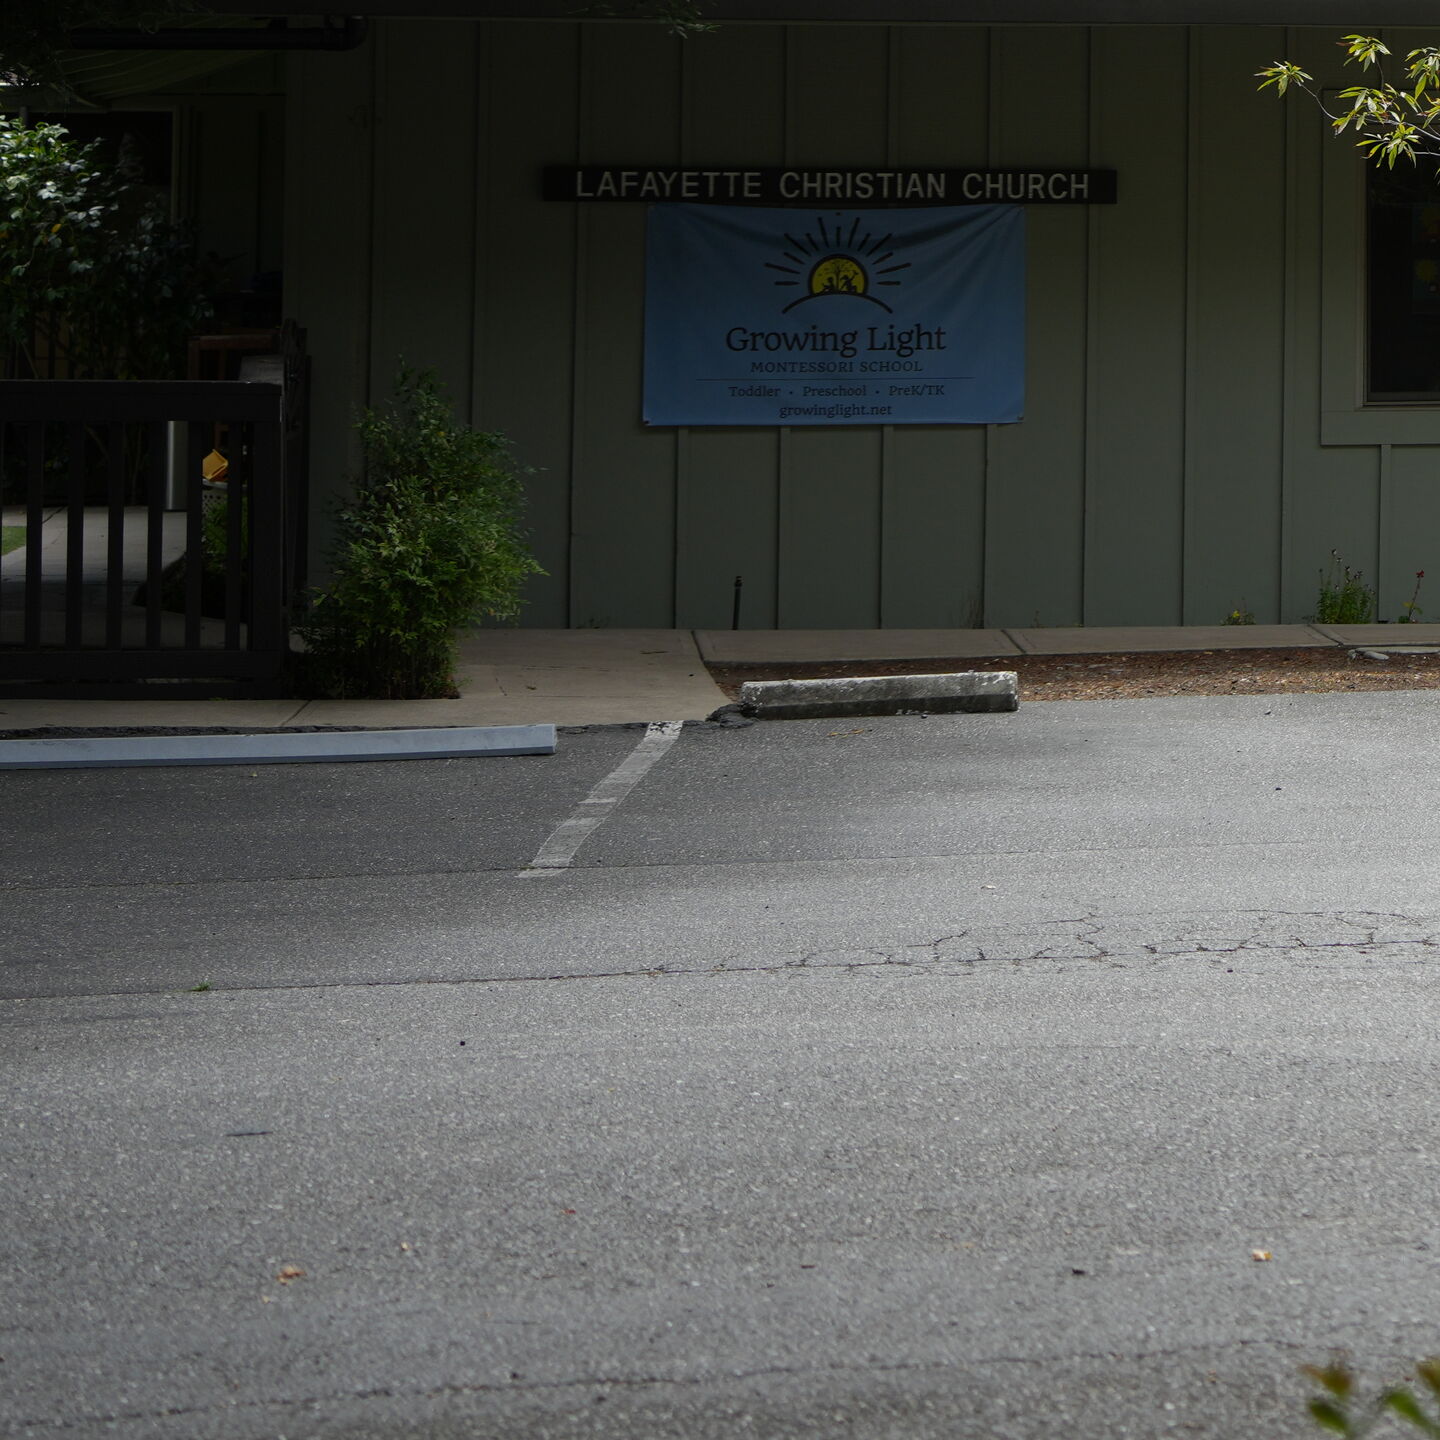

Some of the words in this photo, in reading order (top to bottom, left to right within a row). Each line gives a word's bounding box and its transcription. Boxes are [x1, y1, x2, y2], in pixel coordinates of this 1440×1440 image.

[576, 171, 761, 198] LAFAYETTE
[779, 172, 946, 199] CHRISTIAN
[962, 172, 1089, 200] CHURCH
[726, 324, 858, 358] Growing
[867, 323, 947, 358] Light
[751, 361, 854, 373] MONTESSORI
[860, 360, 923, 372] SCHOOL
[728, 385, 781, 398] Toddler
[802, 385, 867, 397] Preschool
[889, 384, 945, 397] PreK/TK
[779, 404, 892, 419] growinglight.net
